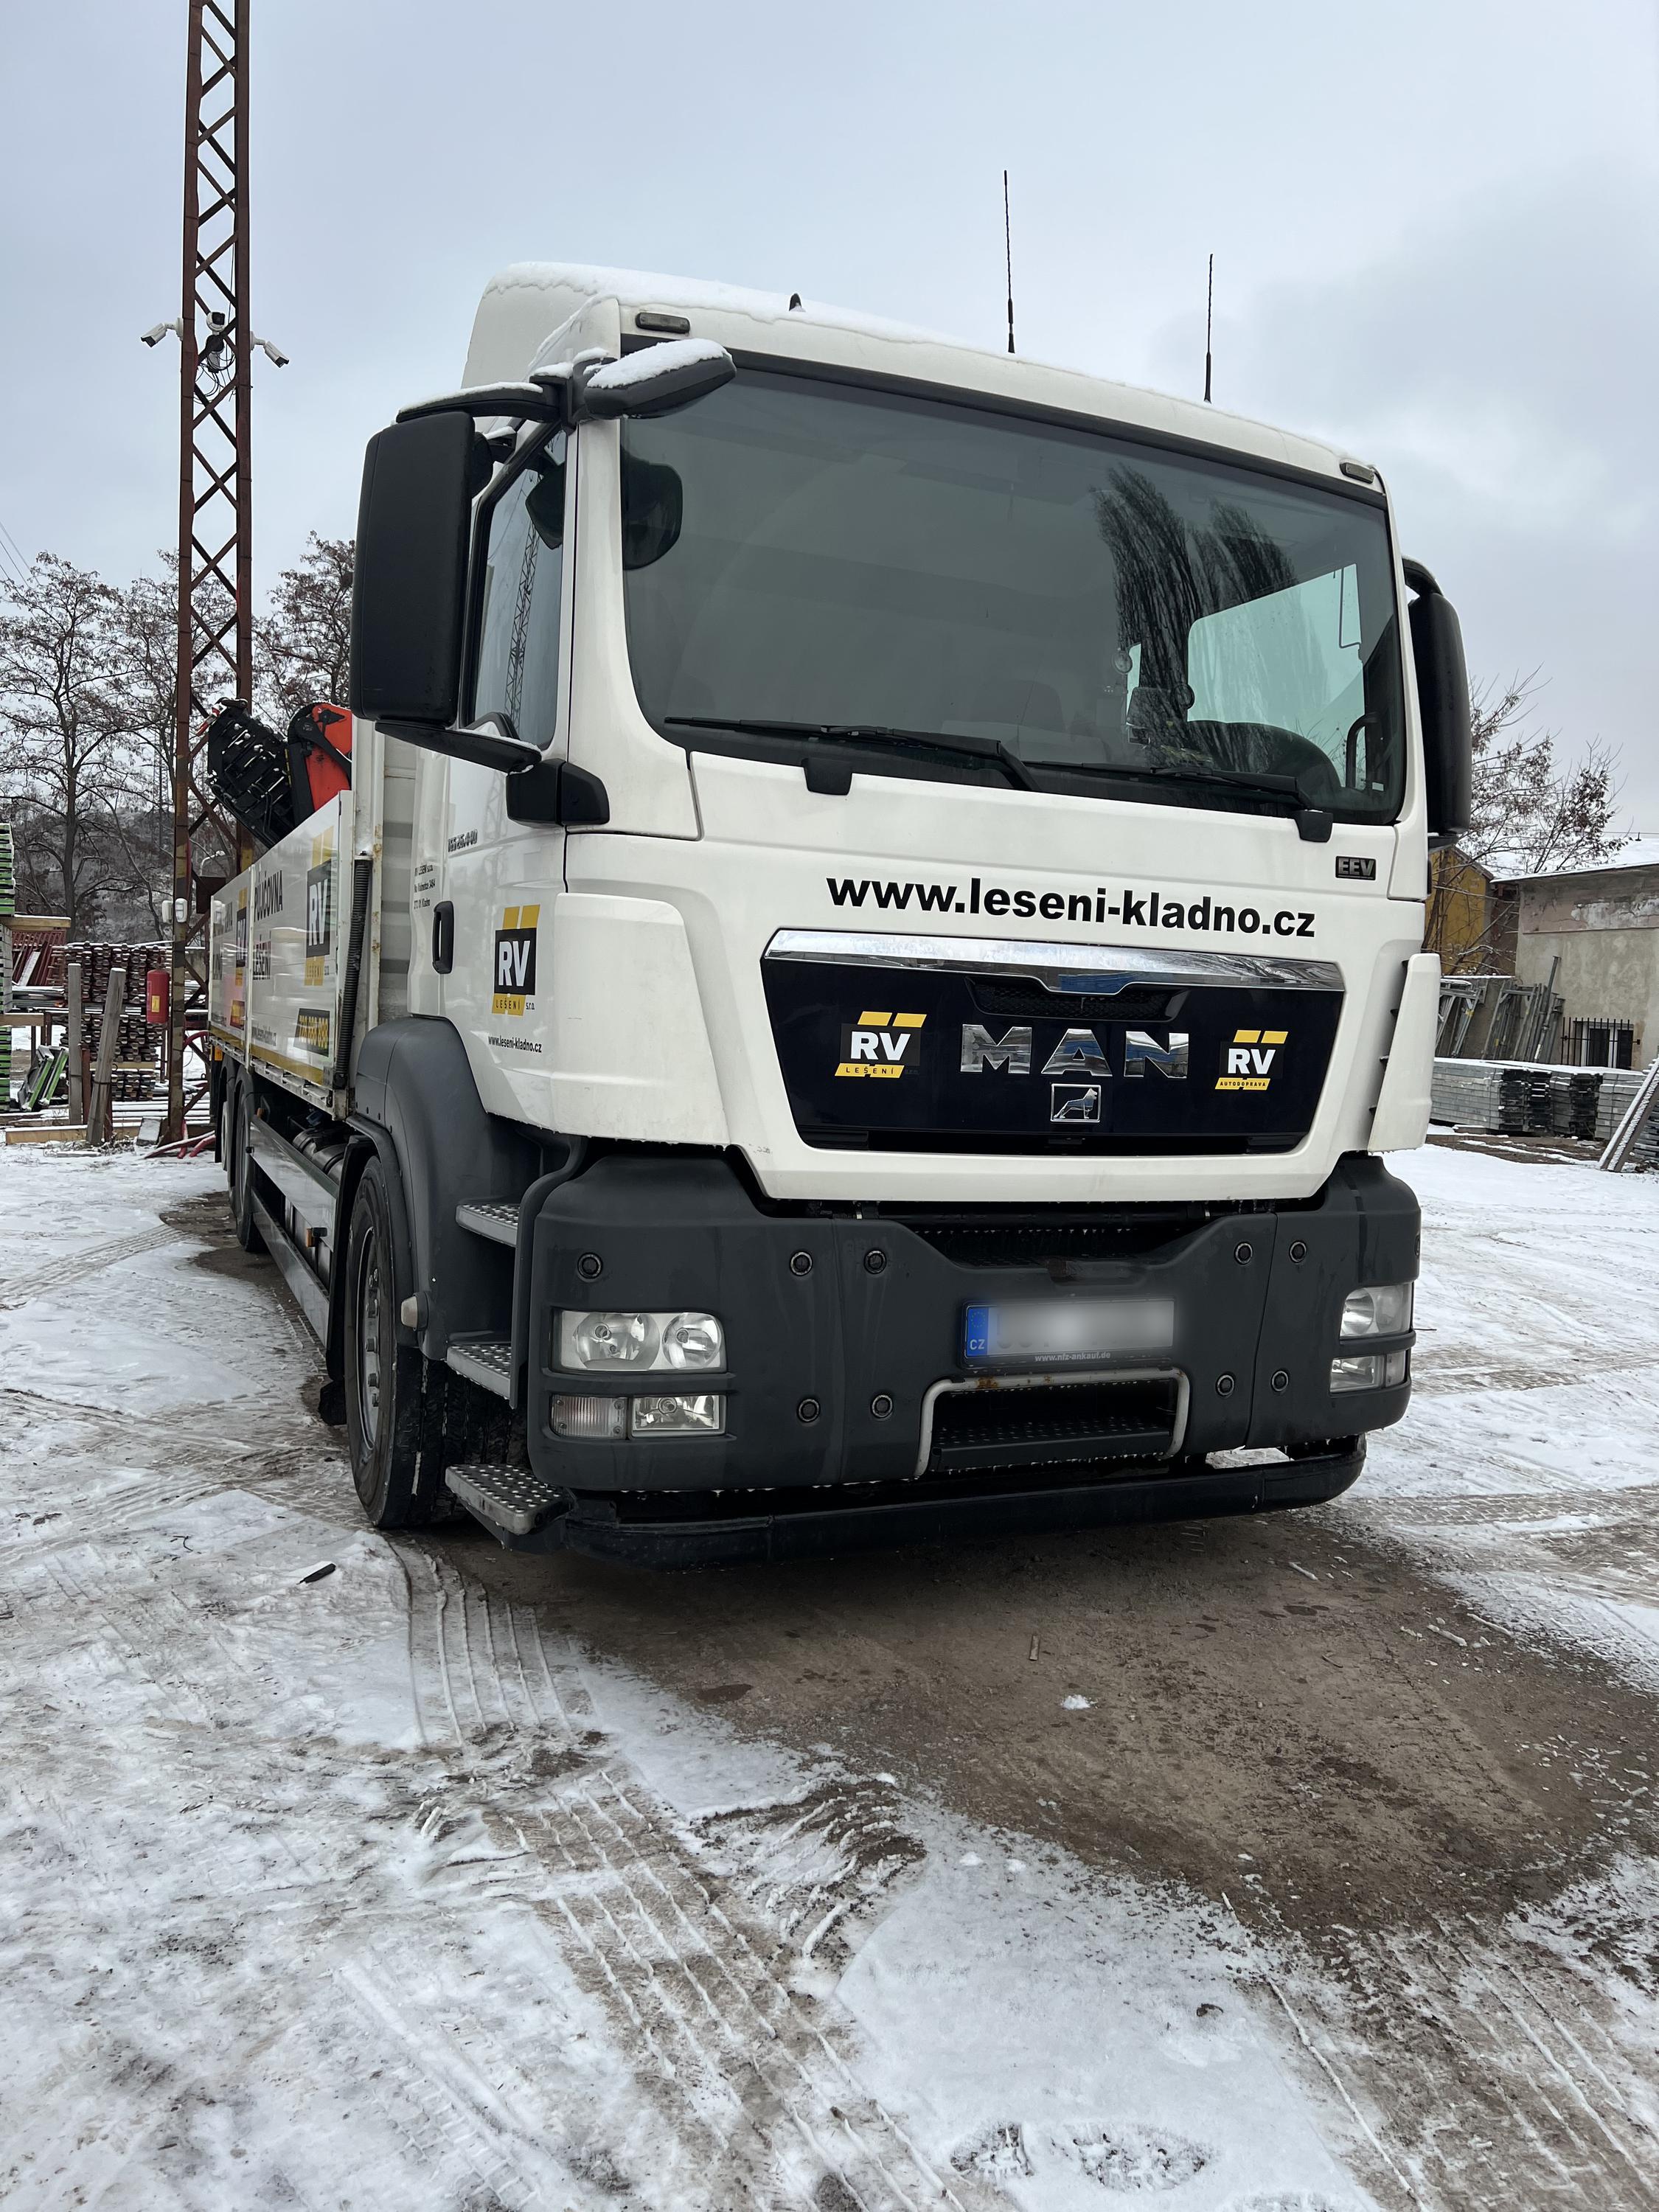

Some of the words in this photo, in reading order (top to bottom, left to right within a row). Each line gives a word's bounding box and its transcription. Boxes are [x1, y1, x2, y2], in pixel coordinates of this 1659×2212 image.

[1338, 858, 1374, 876] EEV
[308, 879, 328, 947] RV
[826, 877, 1316, 938] www.leseni-kladno.cz
[498, 940, 531, 987] RV
[496, 998, 521, 1010] LEŠENÍ
[526, 1002, 535, 1010] s.r.o.
[488, 1034, 542, 1053] www.leseni-kladno.cz
[850, 1031, 911, 1061] RV
[961, 1024, 1189, 1079] MAN
[846, 1066, 894, 1074] LEŠENÍ
[1228, 1048, 1276, 1074] RV
[970, 1339, 985, 1350] CZ
[1034, 1351, 1111, 1363] www.nfz-ankauf.de
